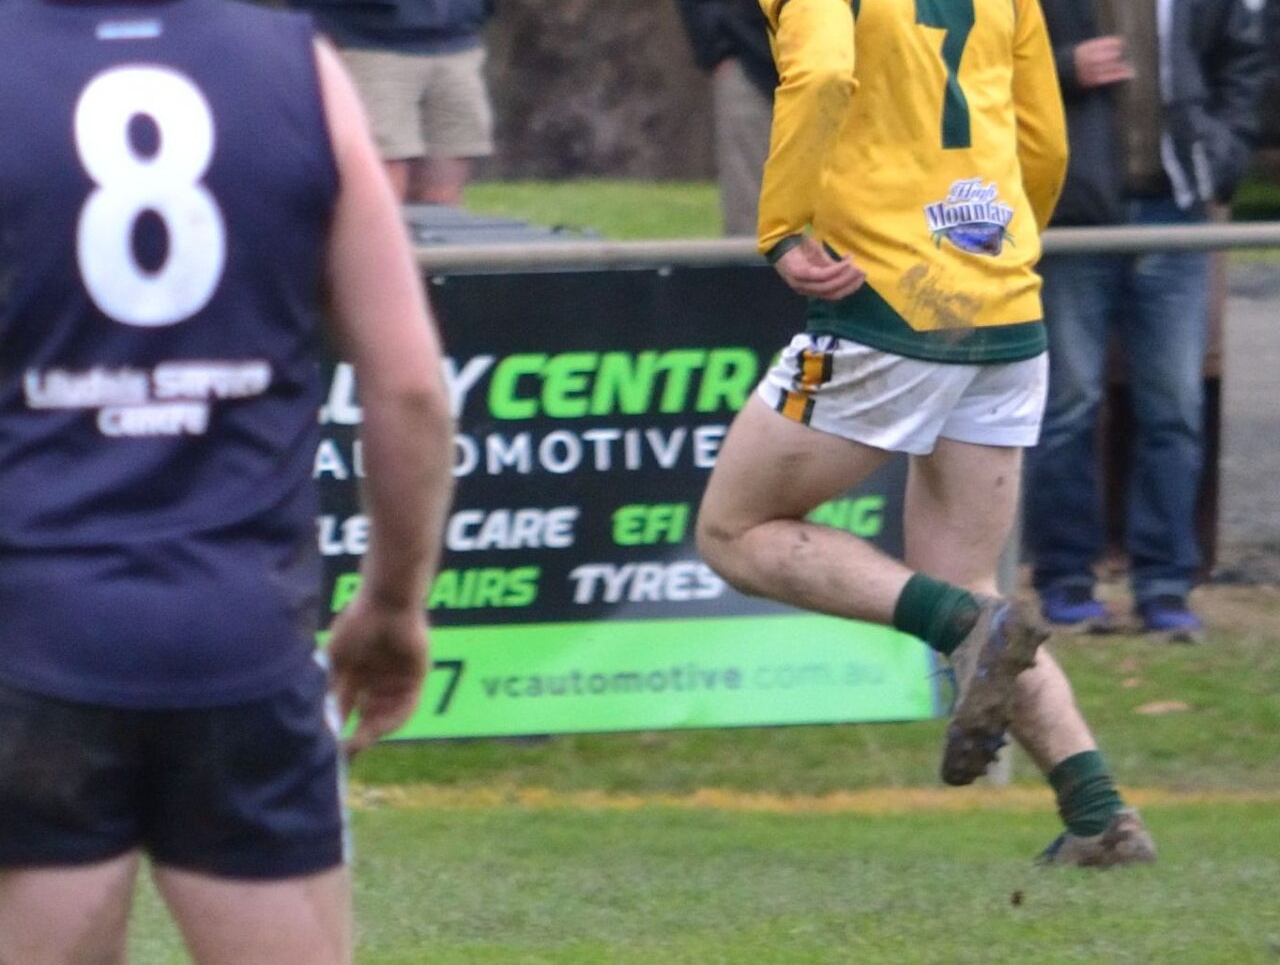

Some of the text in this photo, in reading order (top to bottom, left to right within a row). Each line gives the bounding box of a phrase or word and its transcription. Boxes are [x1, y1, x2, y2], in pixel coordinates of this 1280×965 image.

[74, 64, 228, 328] 8
[487, 346, 780, 421] CENTR
[312, 424, 726, 480] AOMOTIVE
[446, 506, 581, 552] CARE
[611, 502, 690, 546] EFI
[569, 560, 725, 605] TYRES
